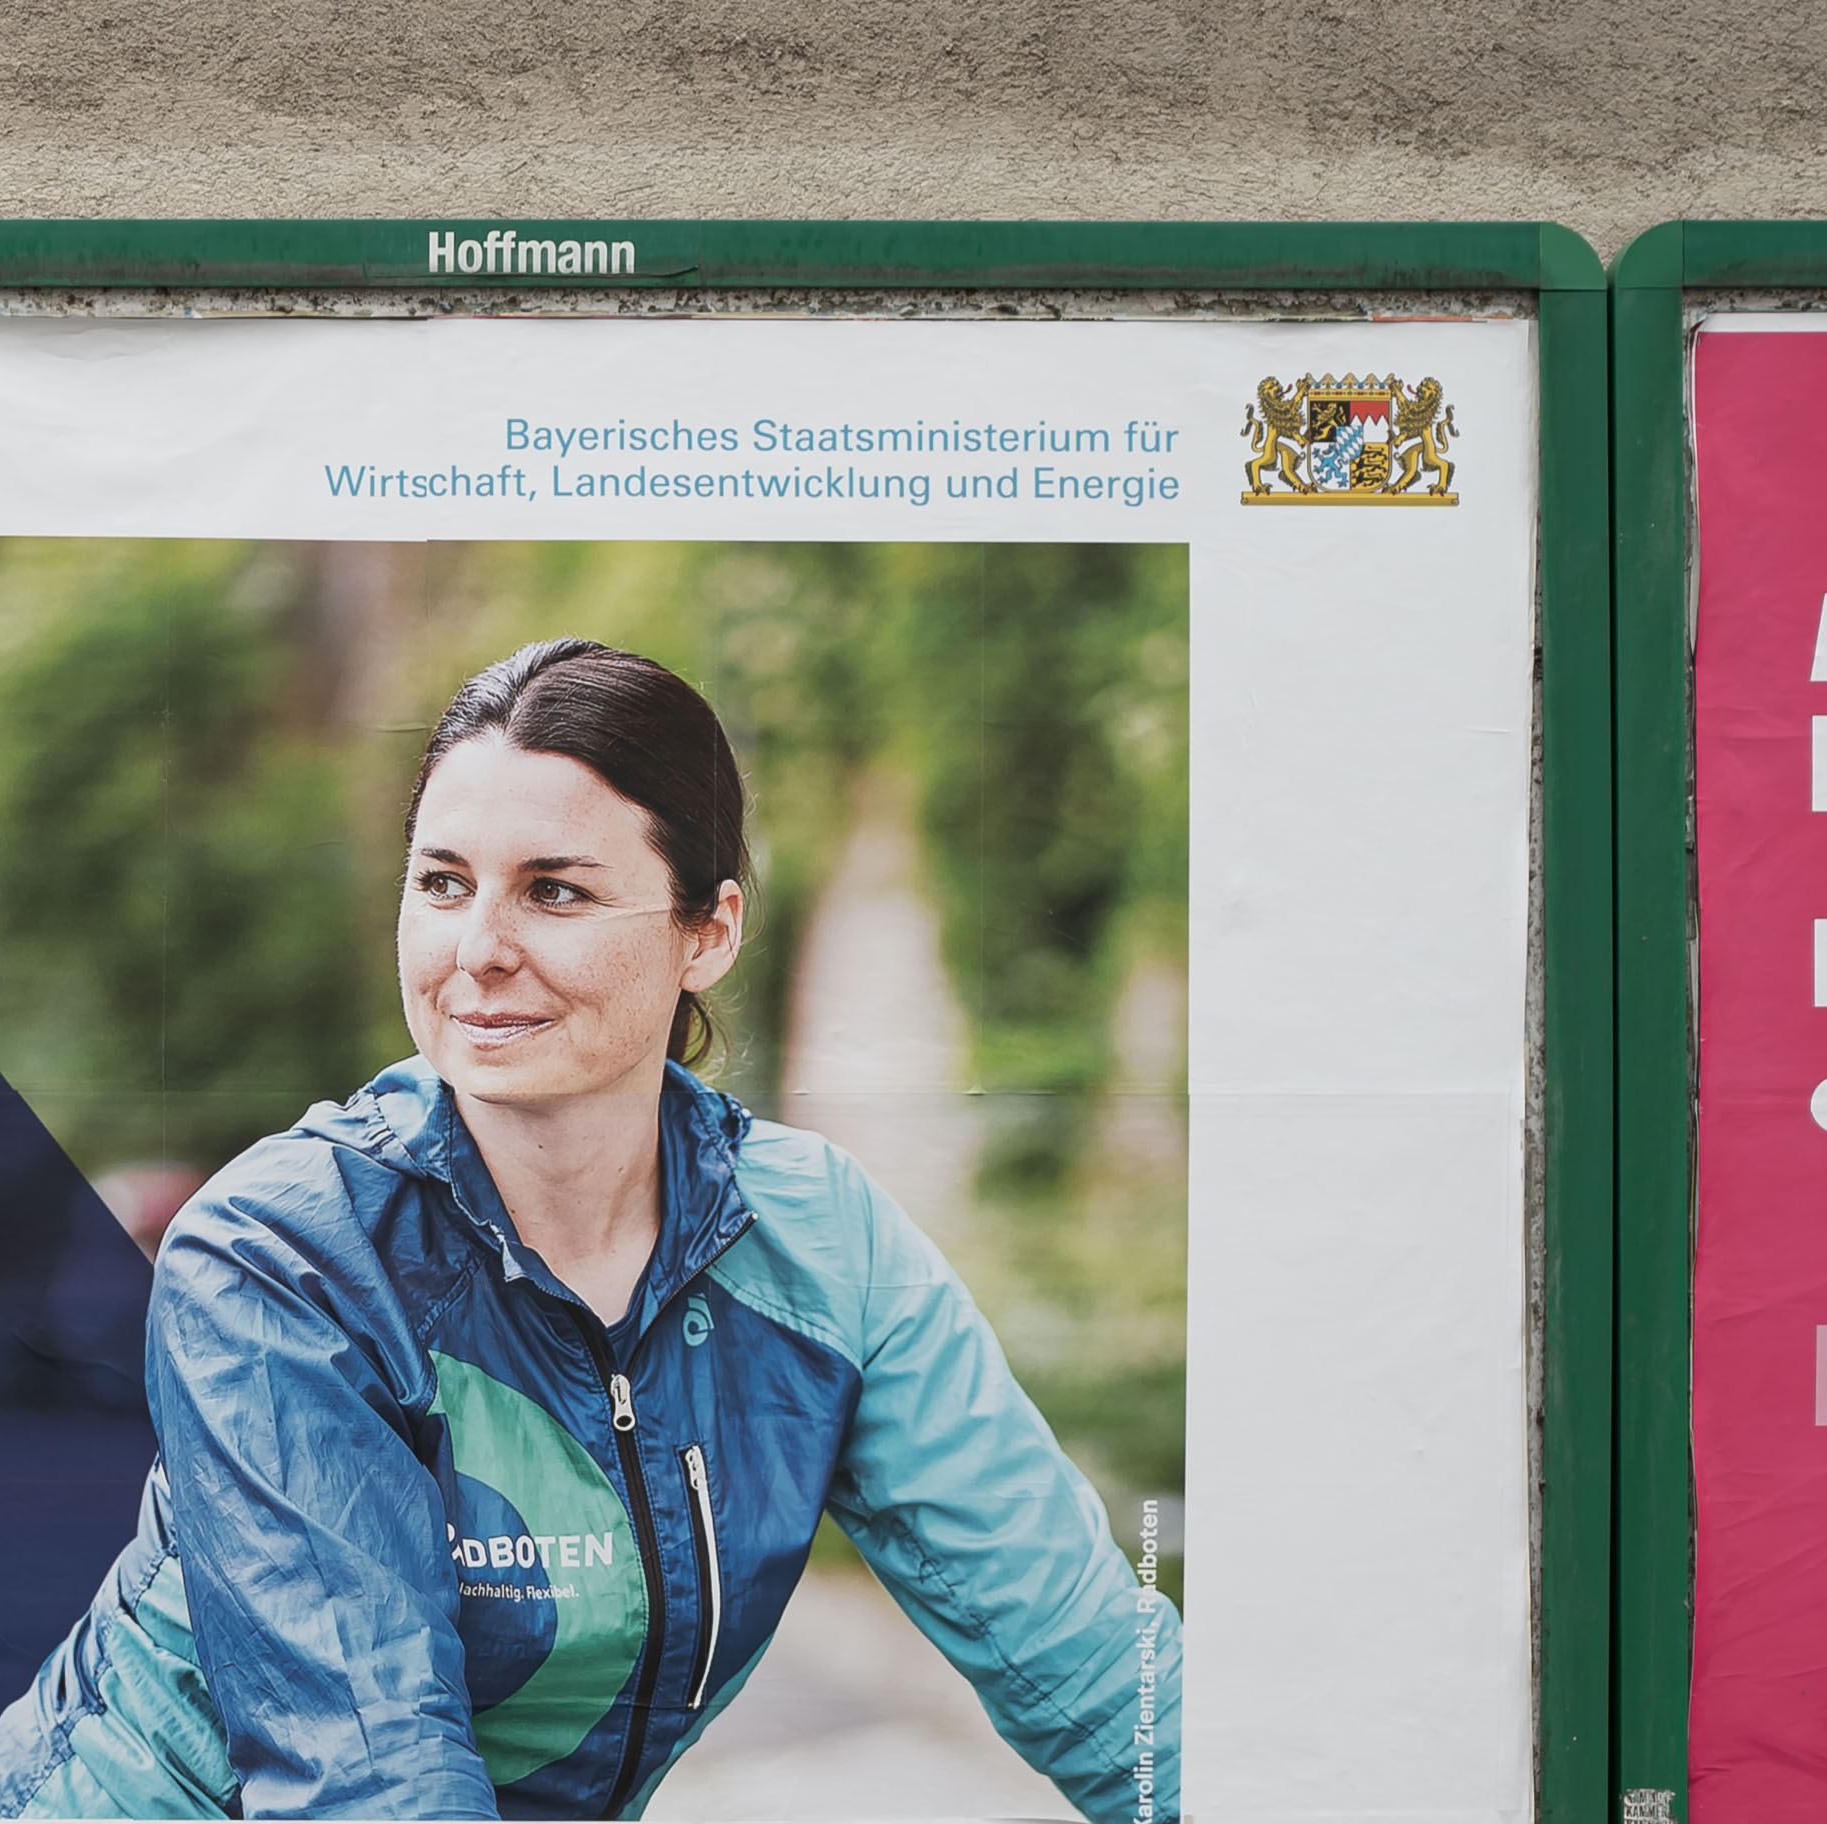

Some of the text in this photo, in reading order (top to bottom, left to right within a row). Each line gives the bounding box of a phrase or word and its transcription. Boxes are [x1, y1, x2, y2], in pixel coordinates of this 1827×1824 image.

[428, 230, 636, 274] Hoffmann
[506, 418, 1179, 458] Bayerisches Staatsministerium für
[324, 464, 1180, 508] Wirtschaft, Landesentwicklung und Energie
[1137, 1499, 1158, 1614] Radboten
